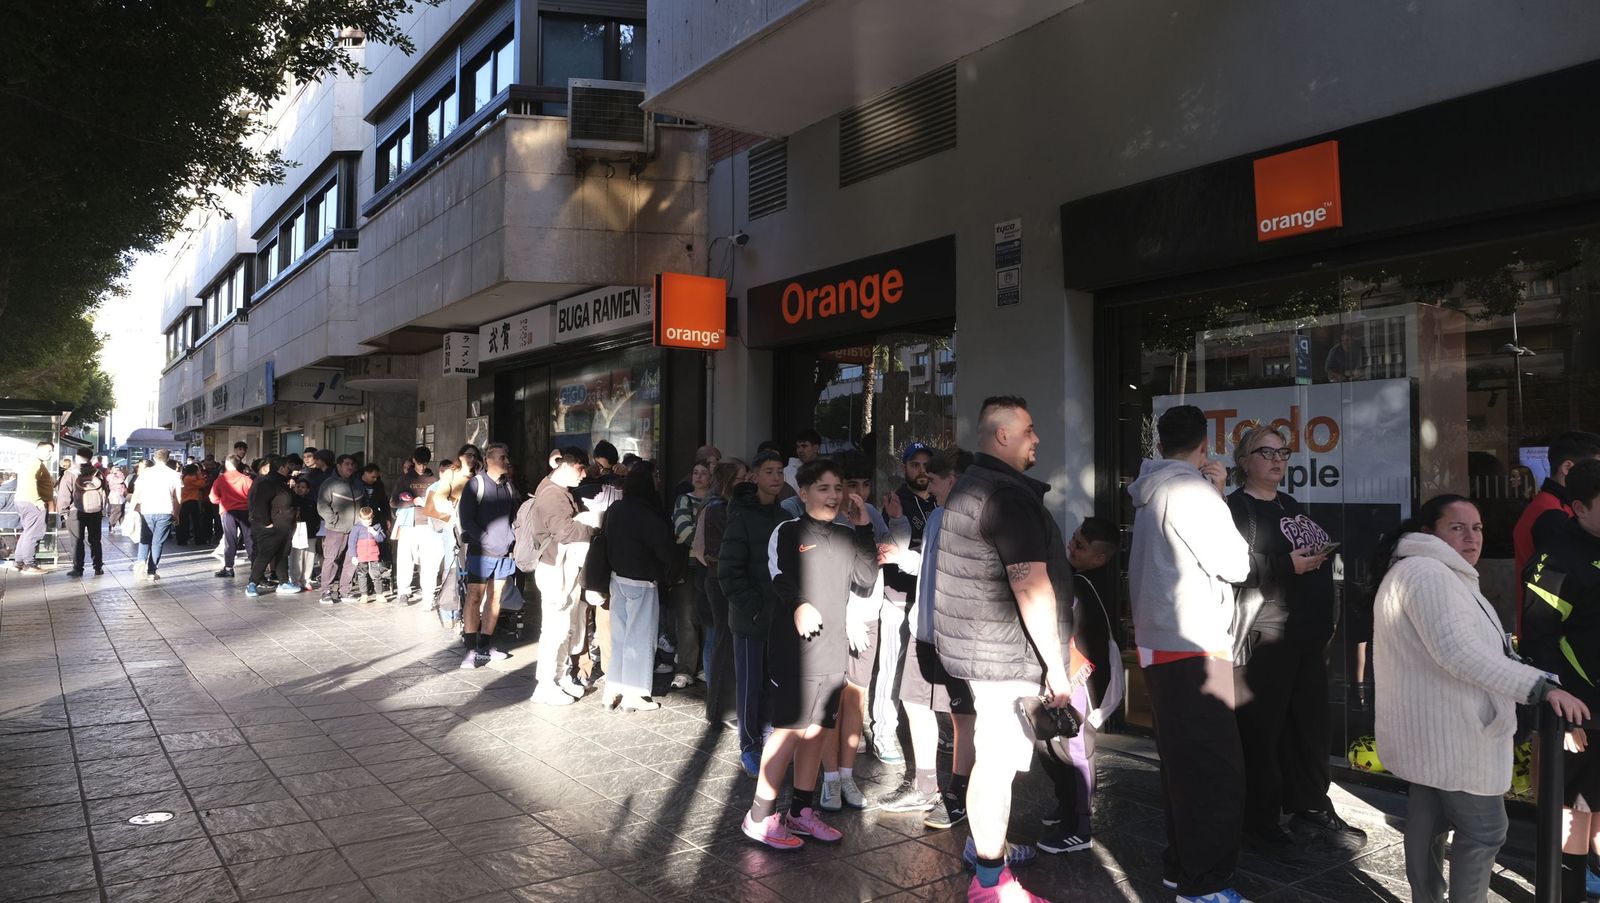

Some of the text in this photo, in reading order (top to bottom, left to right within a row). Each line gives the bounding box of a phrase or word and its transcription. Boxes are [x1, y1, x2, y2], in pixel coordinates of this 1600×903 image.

[1260, 207, 1327, 233] orange
[558, 302, 590, 333] BUGA
[593, 287, 640, 325] RAMEN
[781, 268, 904, 324] Orange
[461, 335, 470, 367] ラーメン
[666, 327, 720, 346] orange
